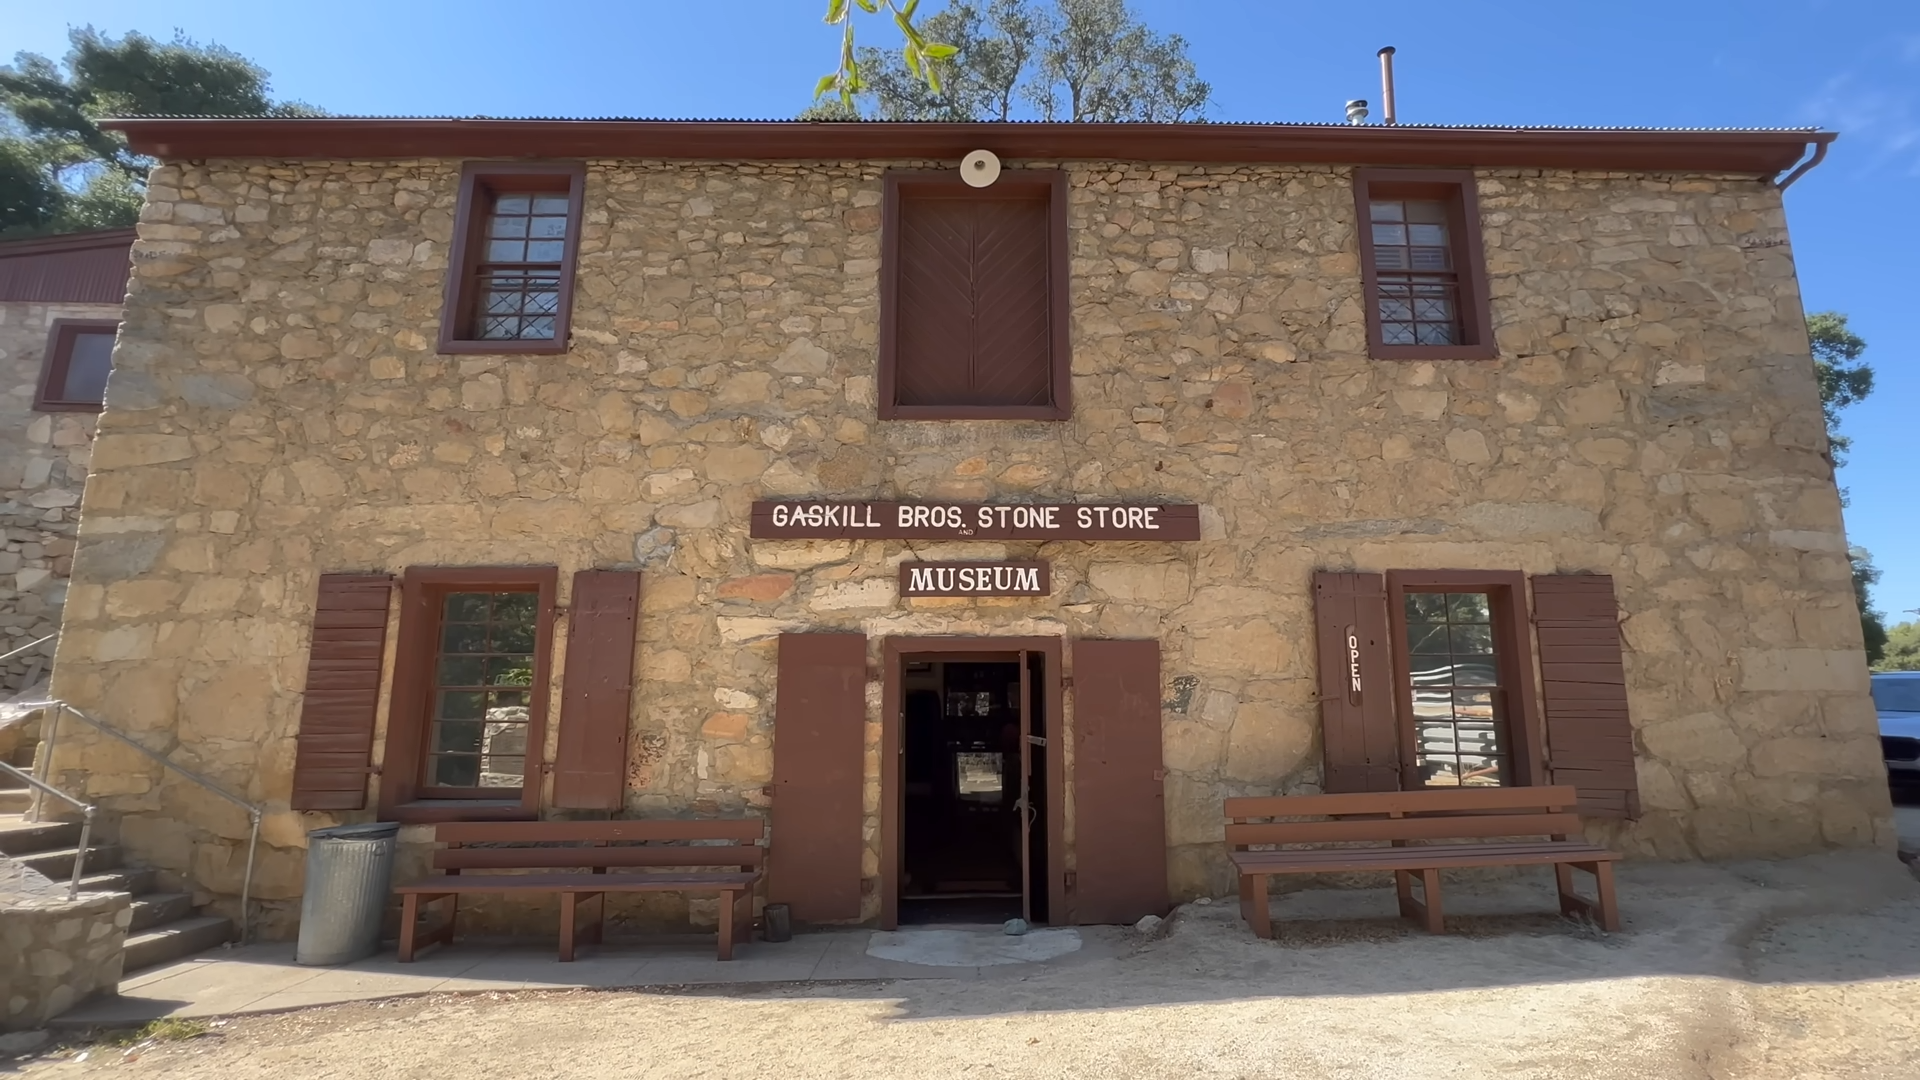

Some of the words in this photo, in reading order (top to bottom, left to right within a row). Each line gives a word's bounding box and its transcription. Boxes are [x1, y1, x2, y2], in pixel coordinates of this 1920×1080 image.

[772, 504, 881, 528] GASKILL
[898, 506, 967, 528] BROS.
[978, 506, 1061, 529] STONE
[1076, 506, 1160, 530] STORE
[908, 566, 1041, 592] MUSEUM
[1348, 635, 1361, 692] OPEN
